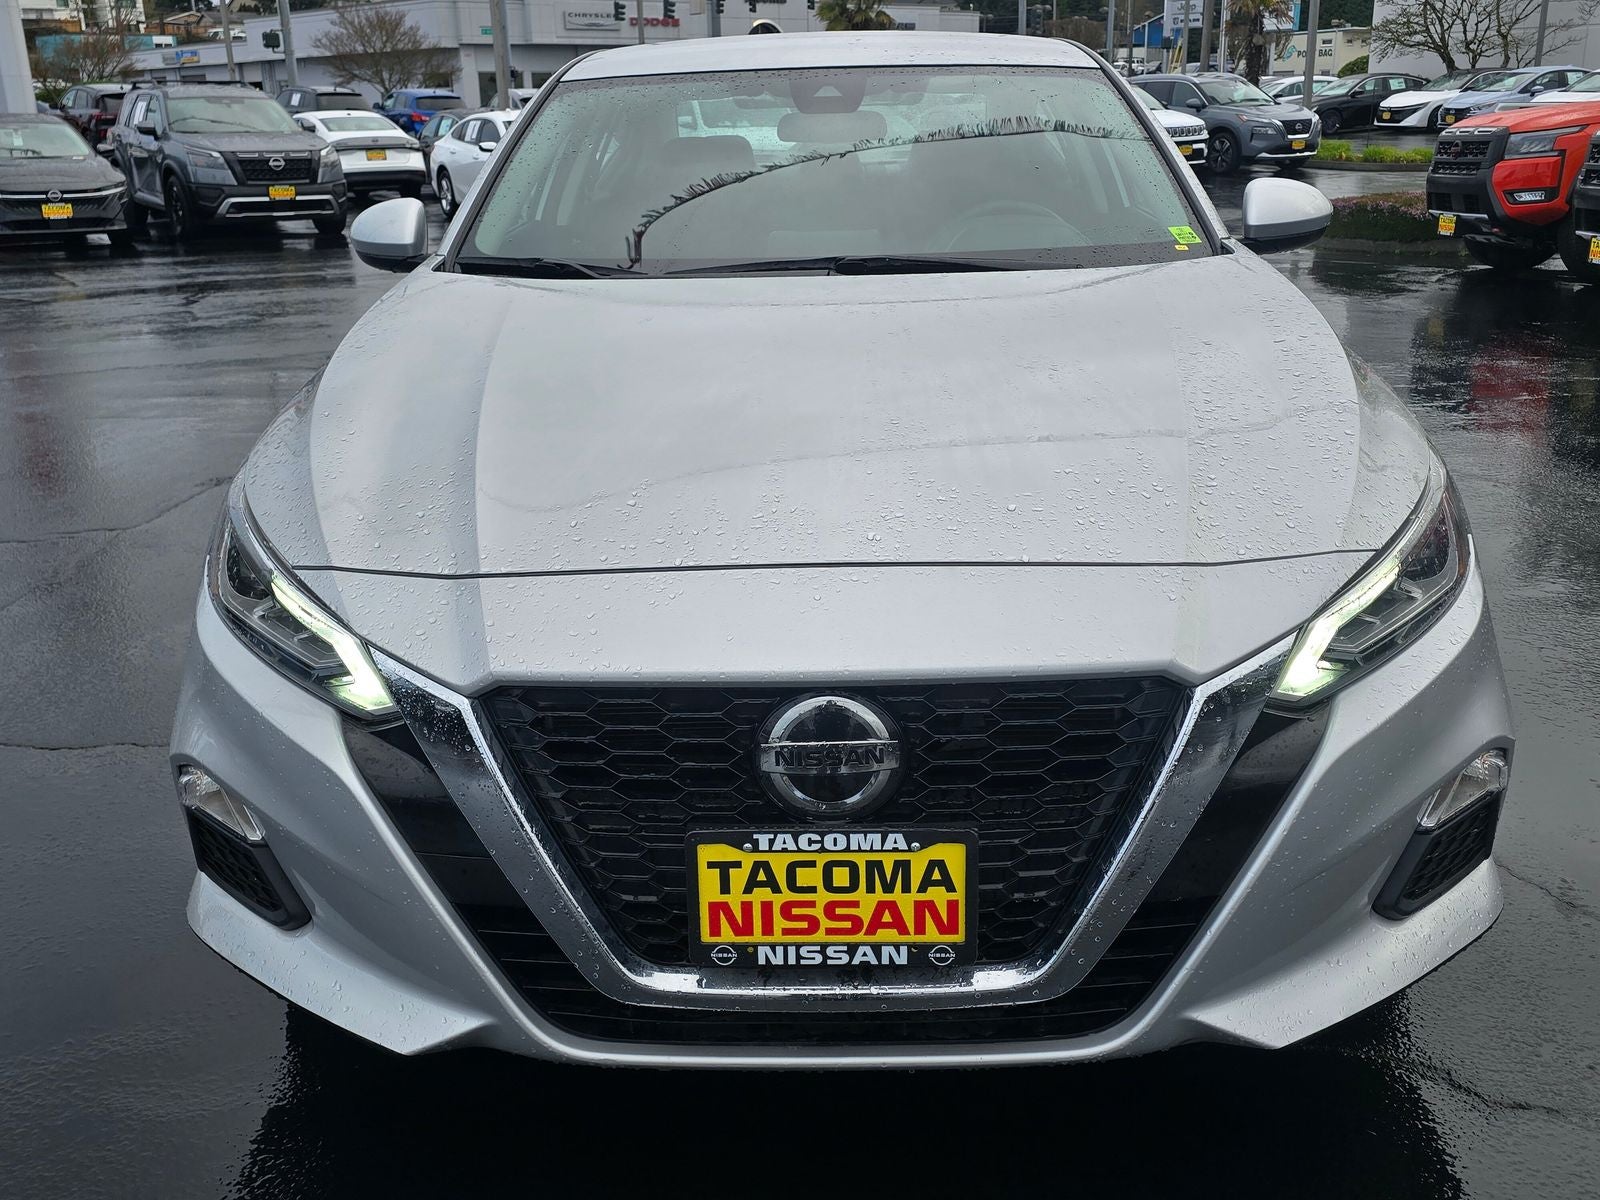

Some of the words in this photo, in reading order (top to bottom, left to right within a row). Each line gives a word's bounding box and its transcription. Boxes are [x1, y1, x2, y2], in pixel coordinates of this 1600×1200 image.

[1318, 49, 1333, 57] BAG
[774, 747, 885, 768] NISSAN
[753, 833, 909, 851] TACOMA
[706, 859, 958, 895] TACOMA
[707, 899, 960, 938] NISSAN
[757, 945, 908, 965] NISSAN
